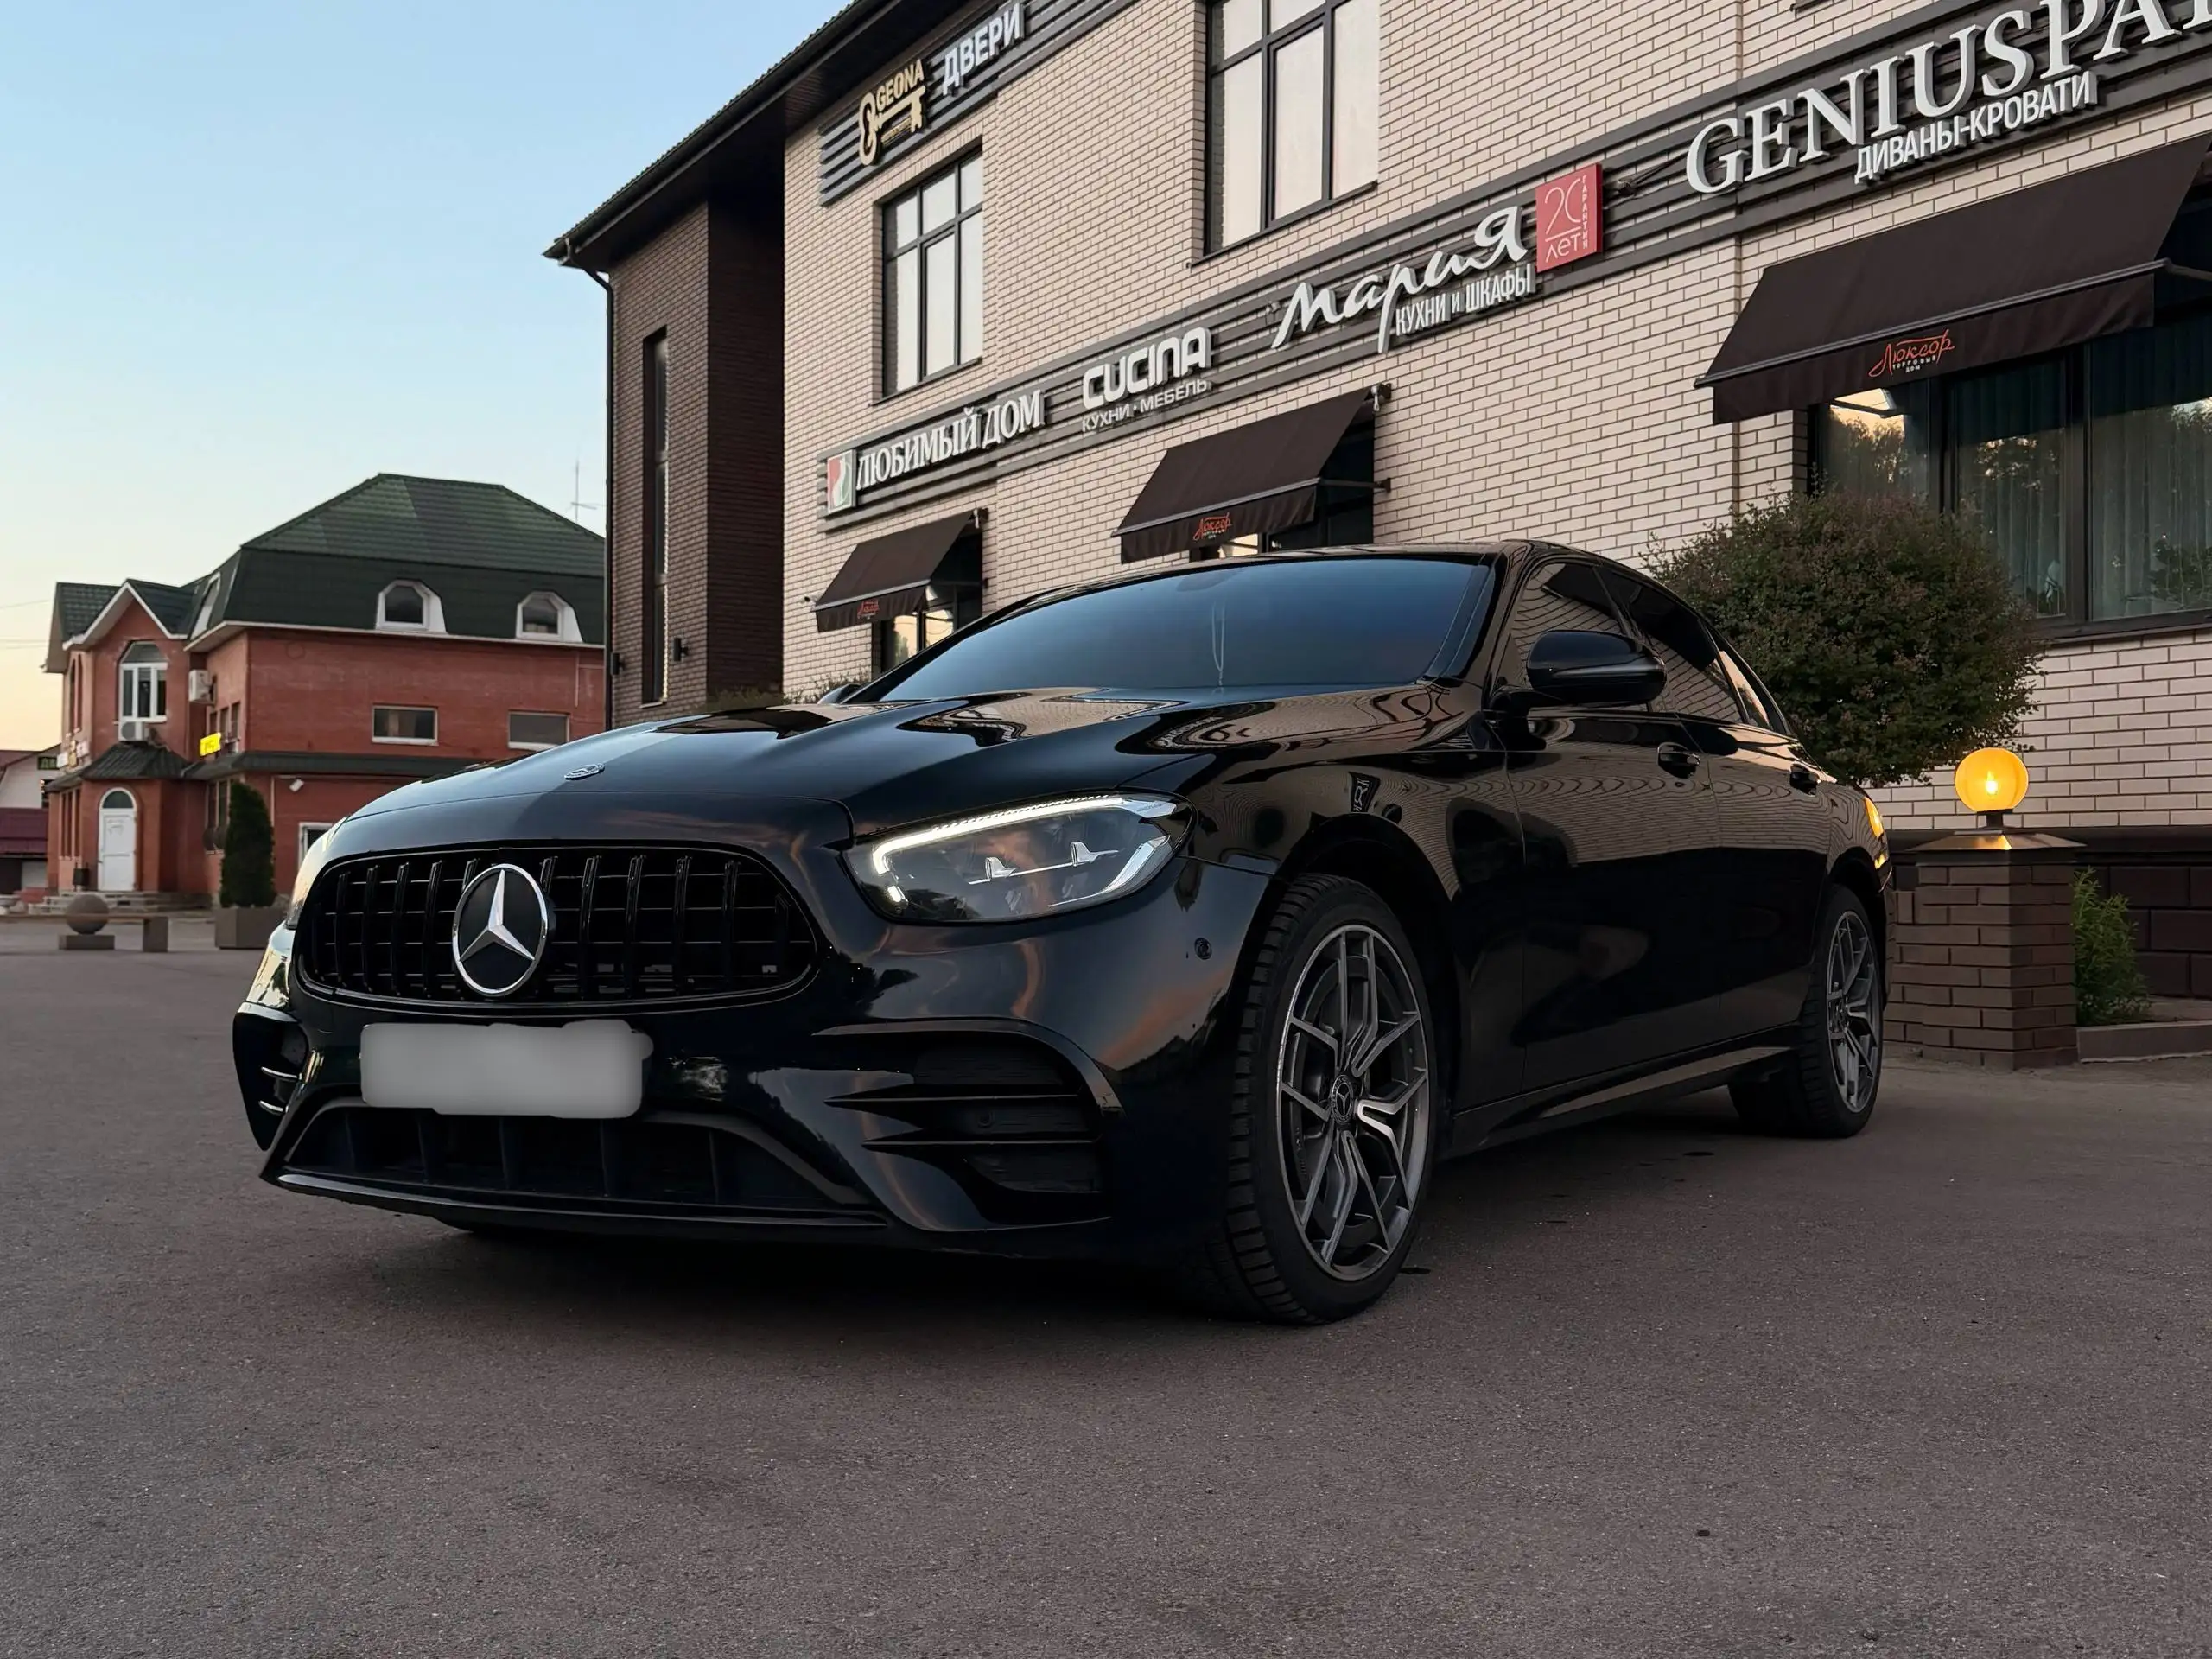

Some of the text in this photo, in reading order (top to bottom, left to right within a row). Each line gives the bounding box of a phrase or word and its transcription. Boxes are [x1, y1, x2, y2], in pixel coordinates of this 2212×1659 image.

[875, 59, 925, 111] GEONA
[943, 3, 1025, 96] ДВЕРИ
[1854, 71, 2098, 184] ДИВАНЫ-КРОВАТИ
[1271, 206, 1529, 354] Мария
[1395, 294, 1449, 337] КУХНИ
[1465, 263, 1534, 314] ШКАФЫ
[856, 390, 1046, 491] ЛЮБИМЫЙ ДОМ
[1082, 378, 1208, 433] КУХНИ МЕБЕЛЬ
